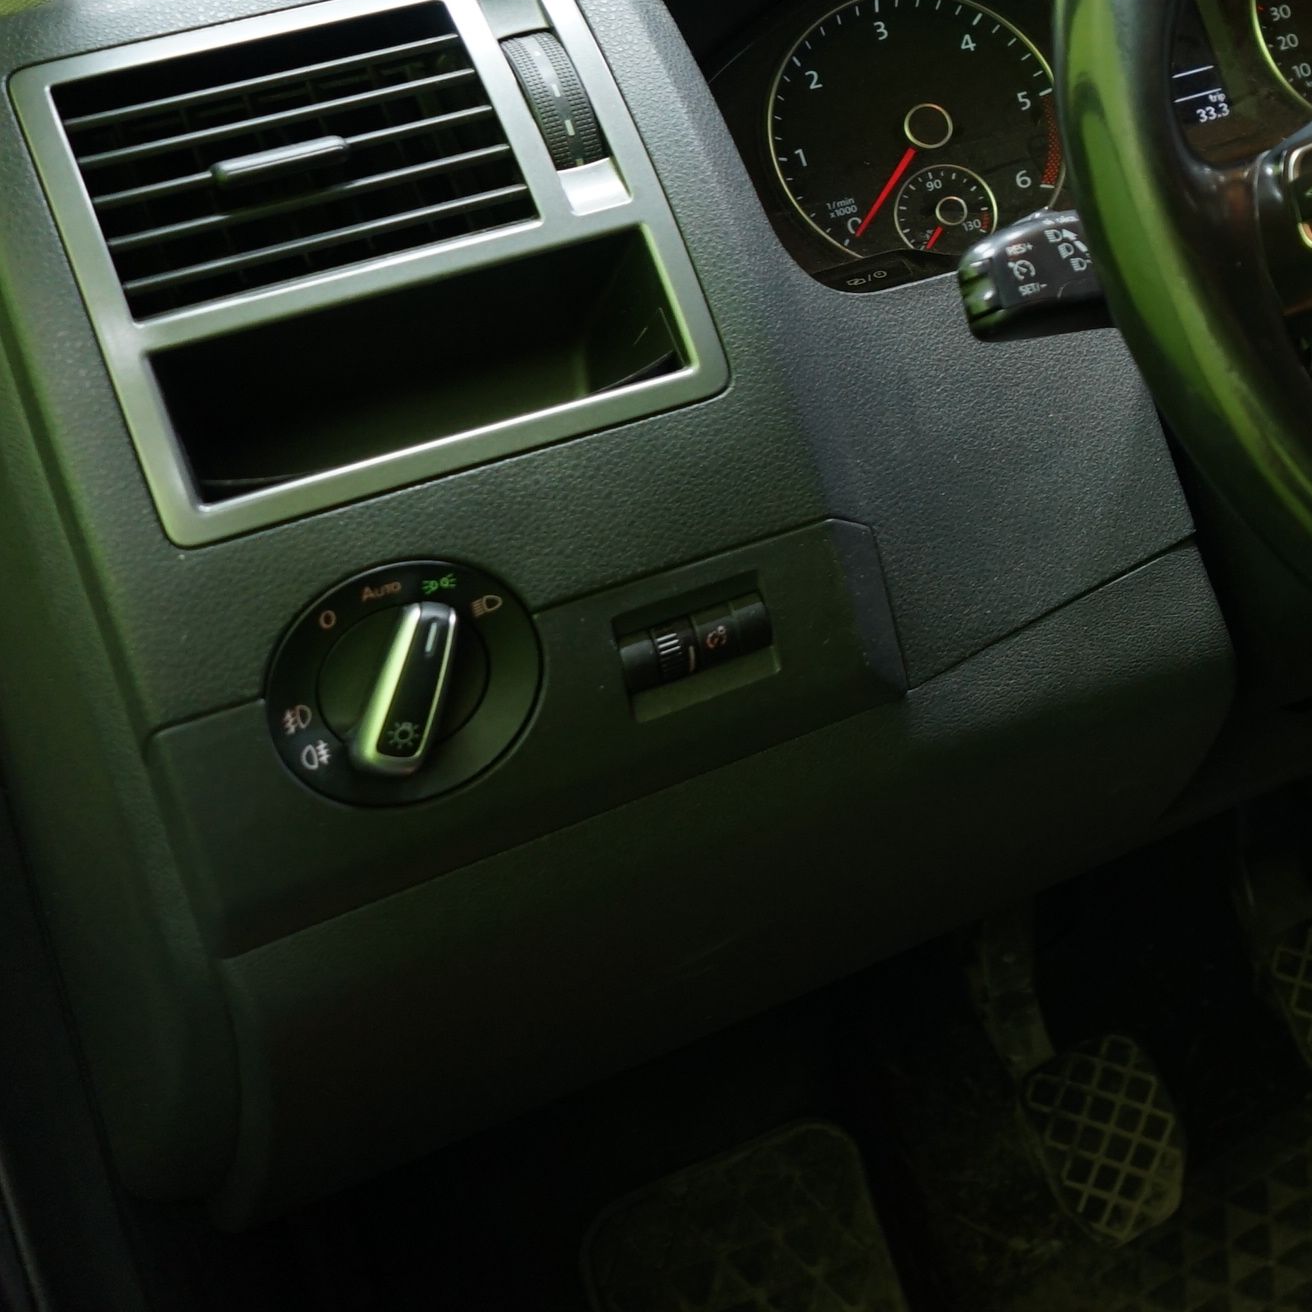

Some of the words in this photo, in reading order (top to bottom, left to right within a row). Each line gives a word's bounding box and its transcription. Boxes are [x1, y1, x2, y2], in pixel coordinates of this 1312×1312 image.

[1269, 4, 1292, 22] 30
[873, 21, 889, 40] 3
[960, 34, 977, 52] 4
[1276, 33, 1299, 51] 20
[1291, 62, 1312, 79] 10
[805, 70, 823, 90] 2
[1017, 91, 1031, 111] 5
[1196, 102, 1230, 123] 33.3
[794, 148, 808, 168] 1
[925, 179, 943, 192] 90
[1015, 170, 1032, 189] 6
[826, 197, 855, 210] 1/min
[829, 204, 858, 218] x1000
[847, 217, 862, 234] 0
[962, 218, 982, 232] 130
